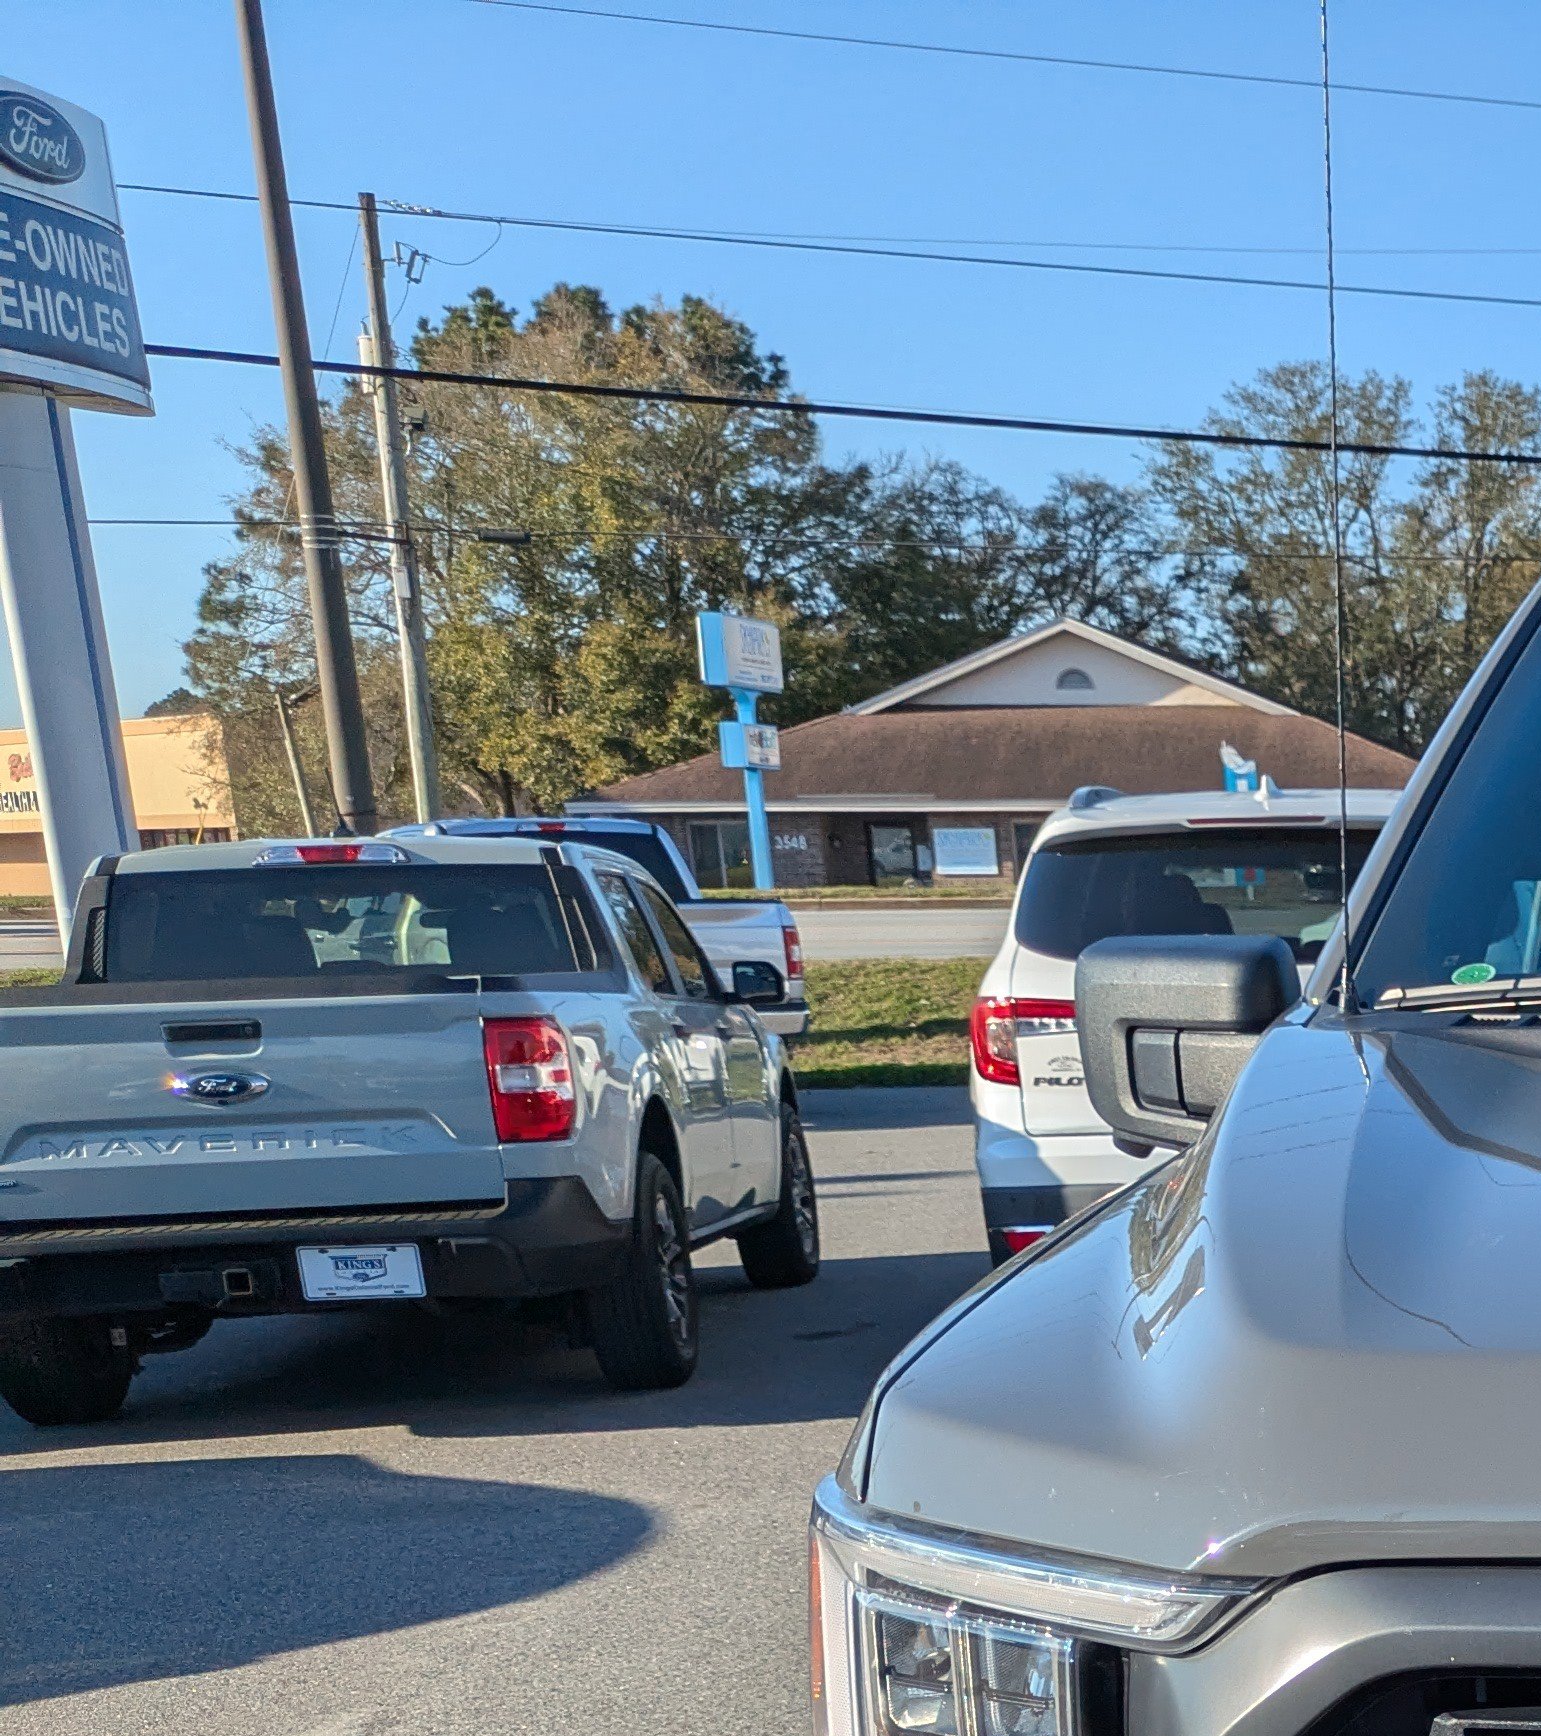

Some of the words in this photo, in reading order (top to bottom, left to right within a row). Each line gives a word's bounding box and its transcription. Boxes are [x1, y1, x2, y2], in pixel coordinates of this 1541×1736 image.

[9, 105, 71, 169] Ford
[0, 276, 130, 358] EHICLES
[198, 1078, 238, 1093] Ford
[38, 1124, 420, 1161] MAVERICK
